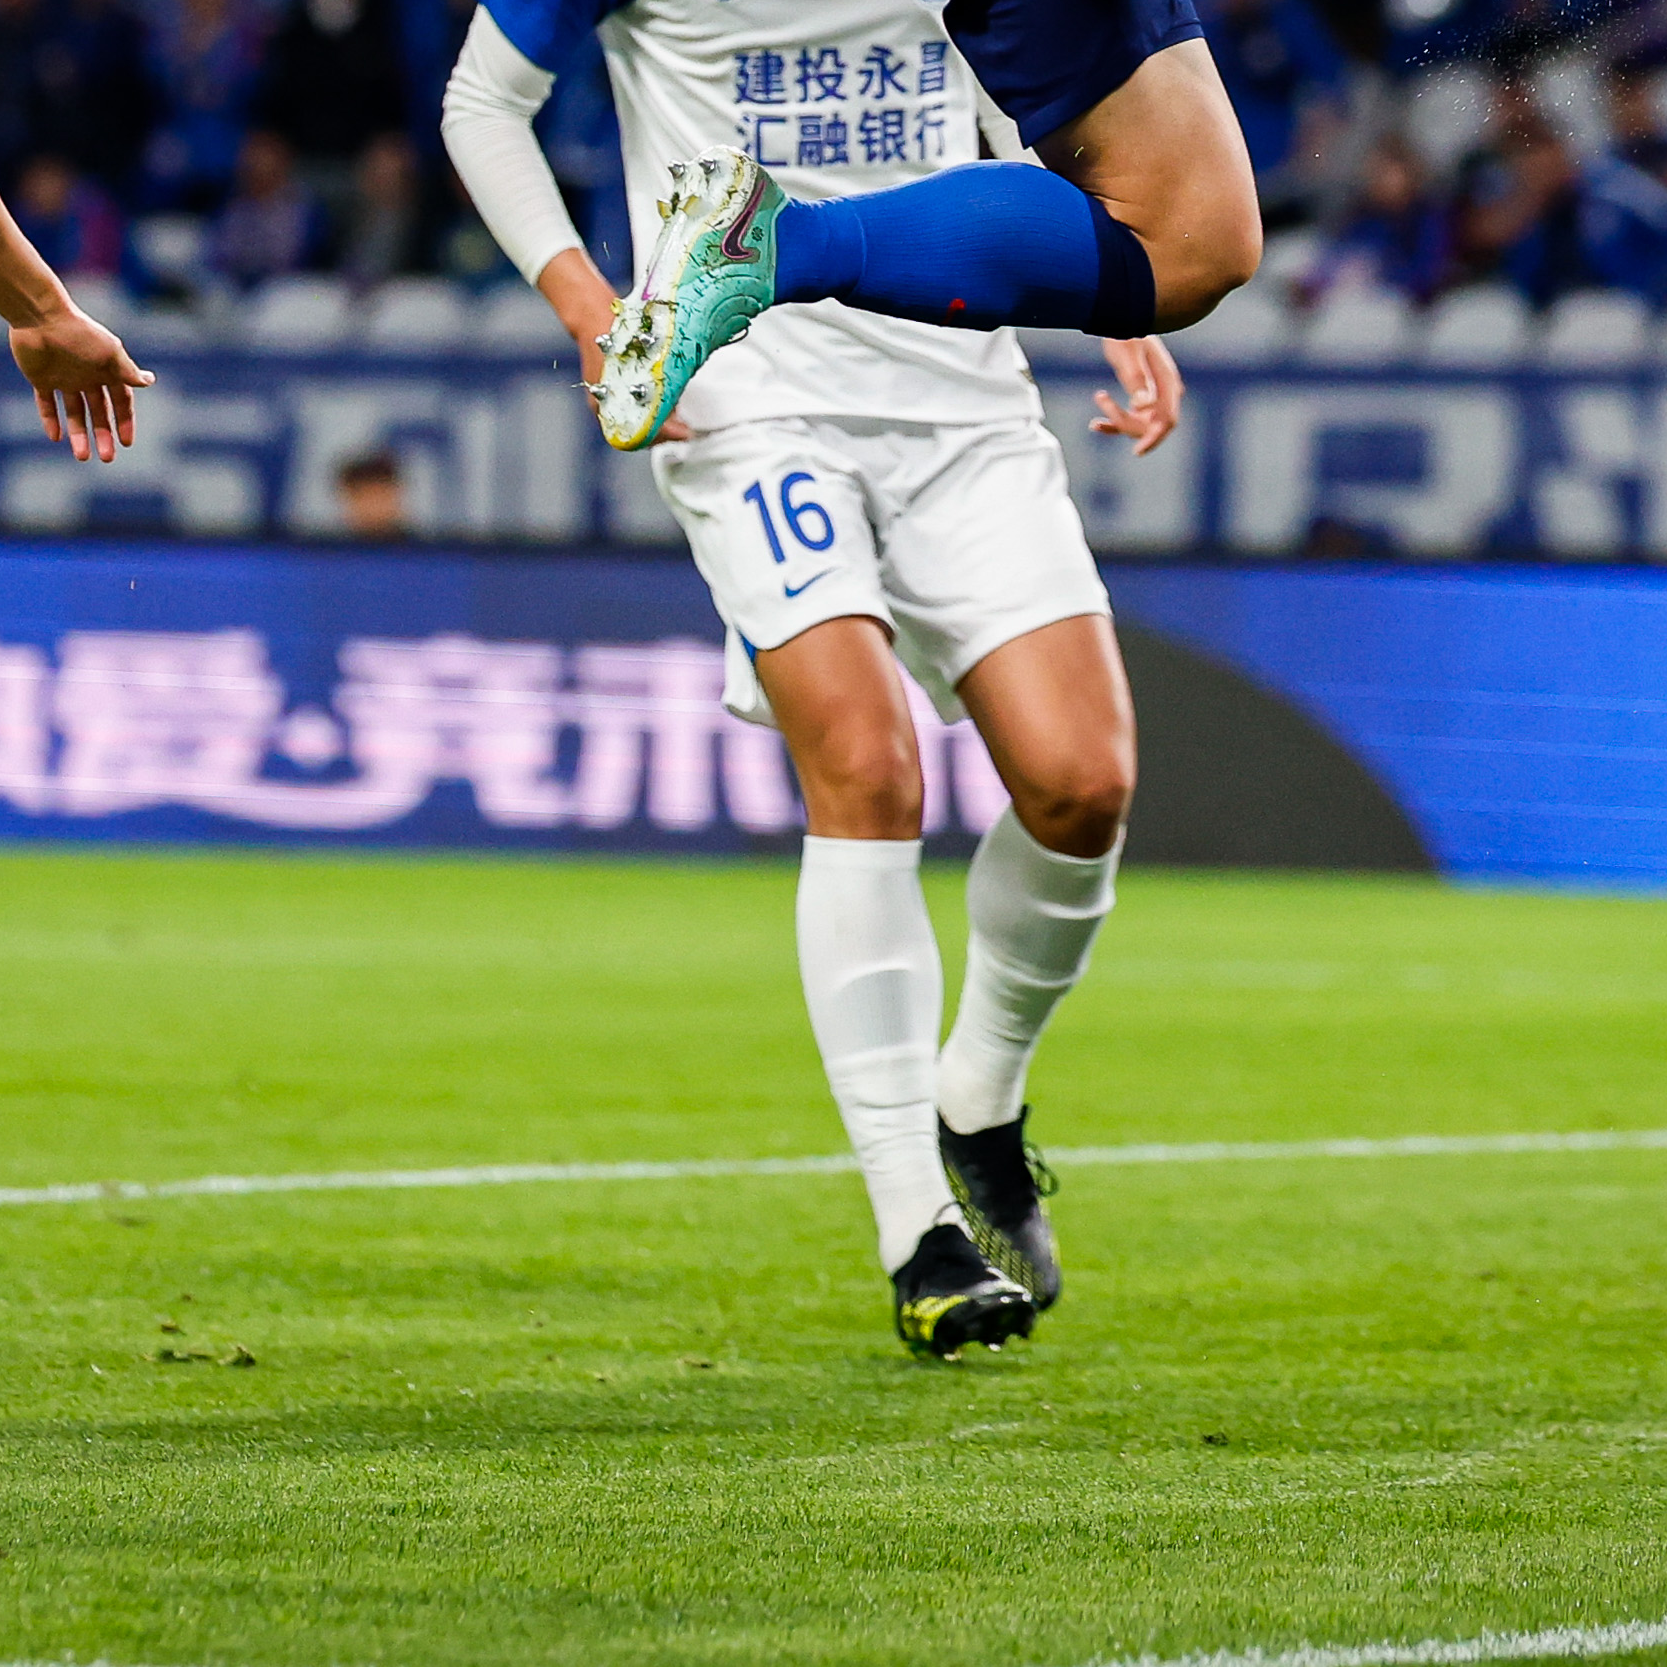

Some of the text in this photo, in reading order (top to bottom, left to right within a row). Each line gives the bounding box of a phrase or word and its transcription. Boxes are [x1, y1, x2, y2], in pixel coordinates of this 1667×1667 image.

[734, 41, 949, 104] 建投永昌
[735, 103, 945, 166] 汇融银行
[743, 471, 835, 563] 16
